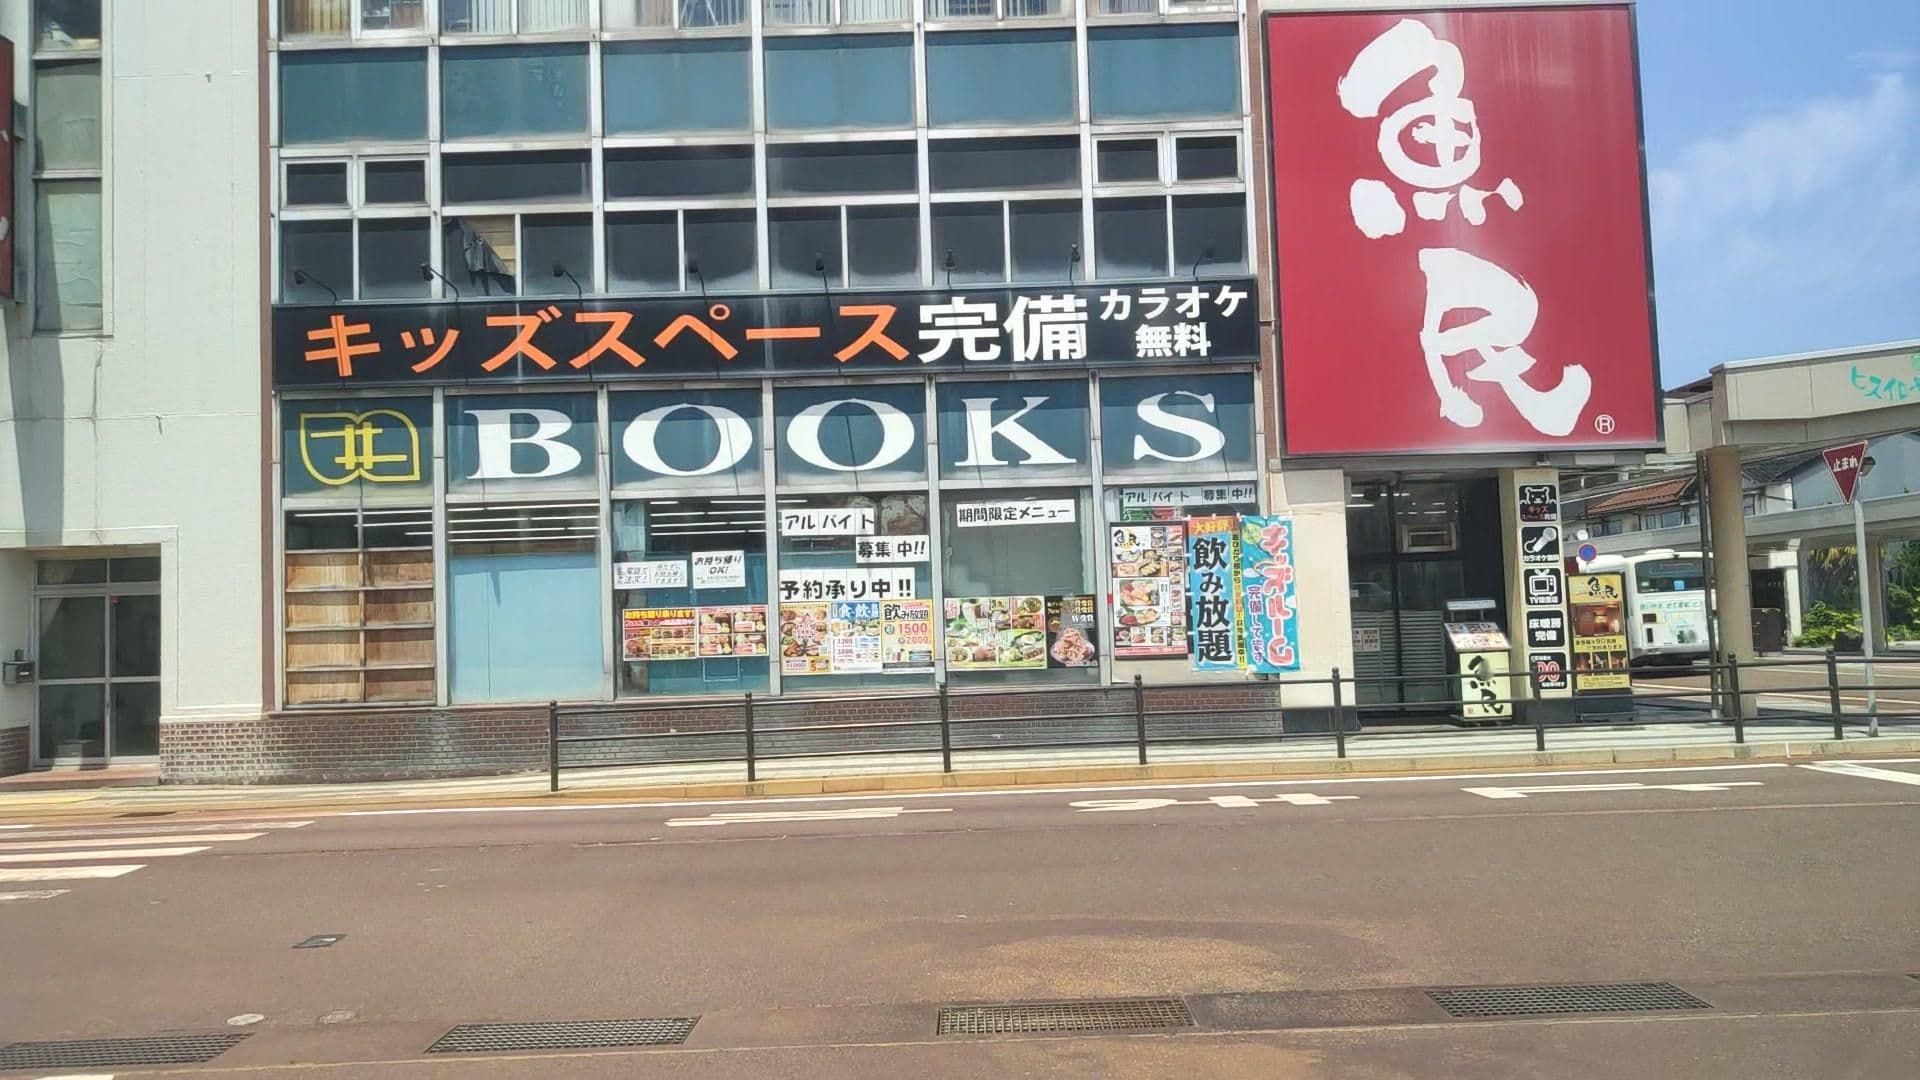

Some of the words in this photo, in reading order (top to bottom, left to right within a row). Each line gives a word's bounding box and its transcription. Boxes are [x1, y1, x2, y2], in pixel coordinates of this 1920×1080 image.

[1337, 18, 1592, 437] 魚民
[1098, 285, 1248, 321] カラオケ
[304, 294, 1088, 378] キッズスペース完備
[1134, 322, 1212, 359] 無料
[462, 390, 1226, 480] BOOKS
[1833, 456, 1859, 472] 止まれ
[1125, 491, 1190, 503] アルバイト
[1203, 487, 1253, 502] 募集中!!
[784, 513, 875, 531] アルバイト
[958, 504, 1072, 524] 期間限定メニュー
[857, 539, 926, 559] 募集中!!
[694, 555, 742, 566] お持ち帰り
[779, 578, 913, 601] 予約承り中!!
[1193, 537, 1233, 663] 飲み放題
[883, 603, 929, 621] 飲み放題
[898, 623, 928, 634] 1500
[1247, 586, 1264, 664] 完備してます
